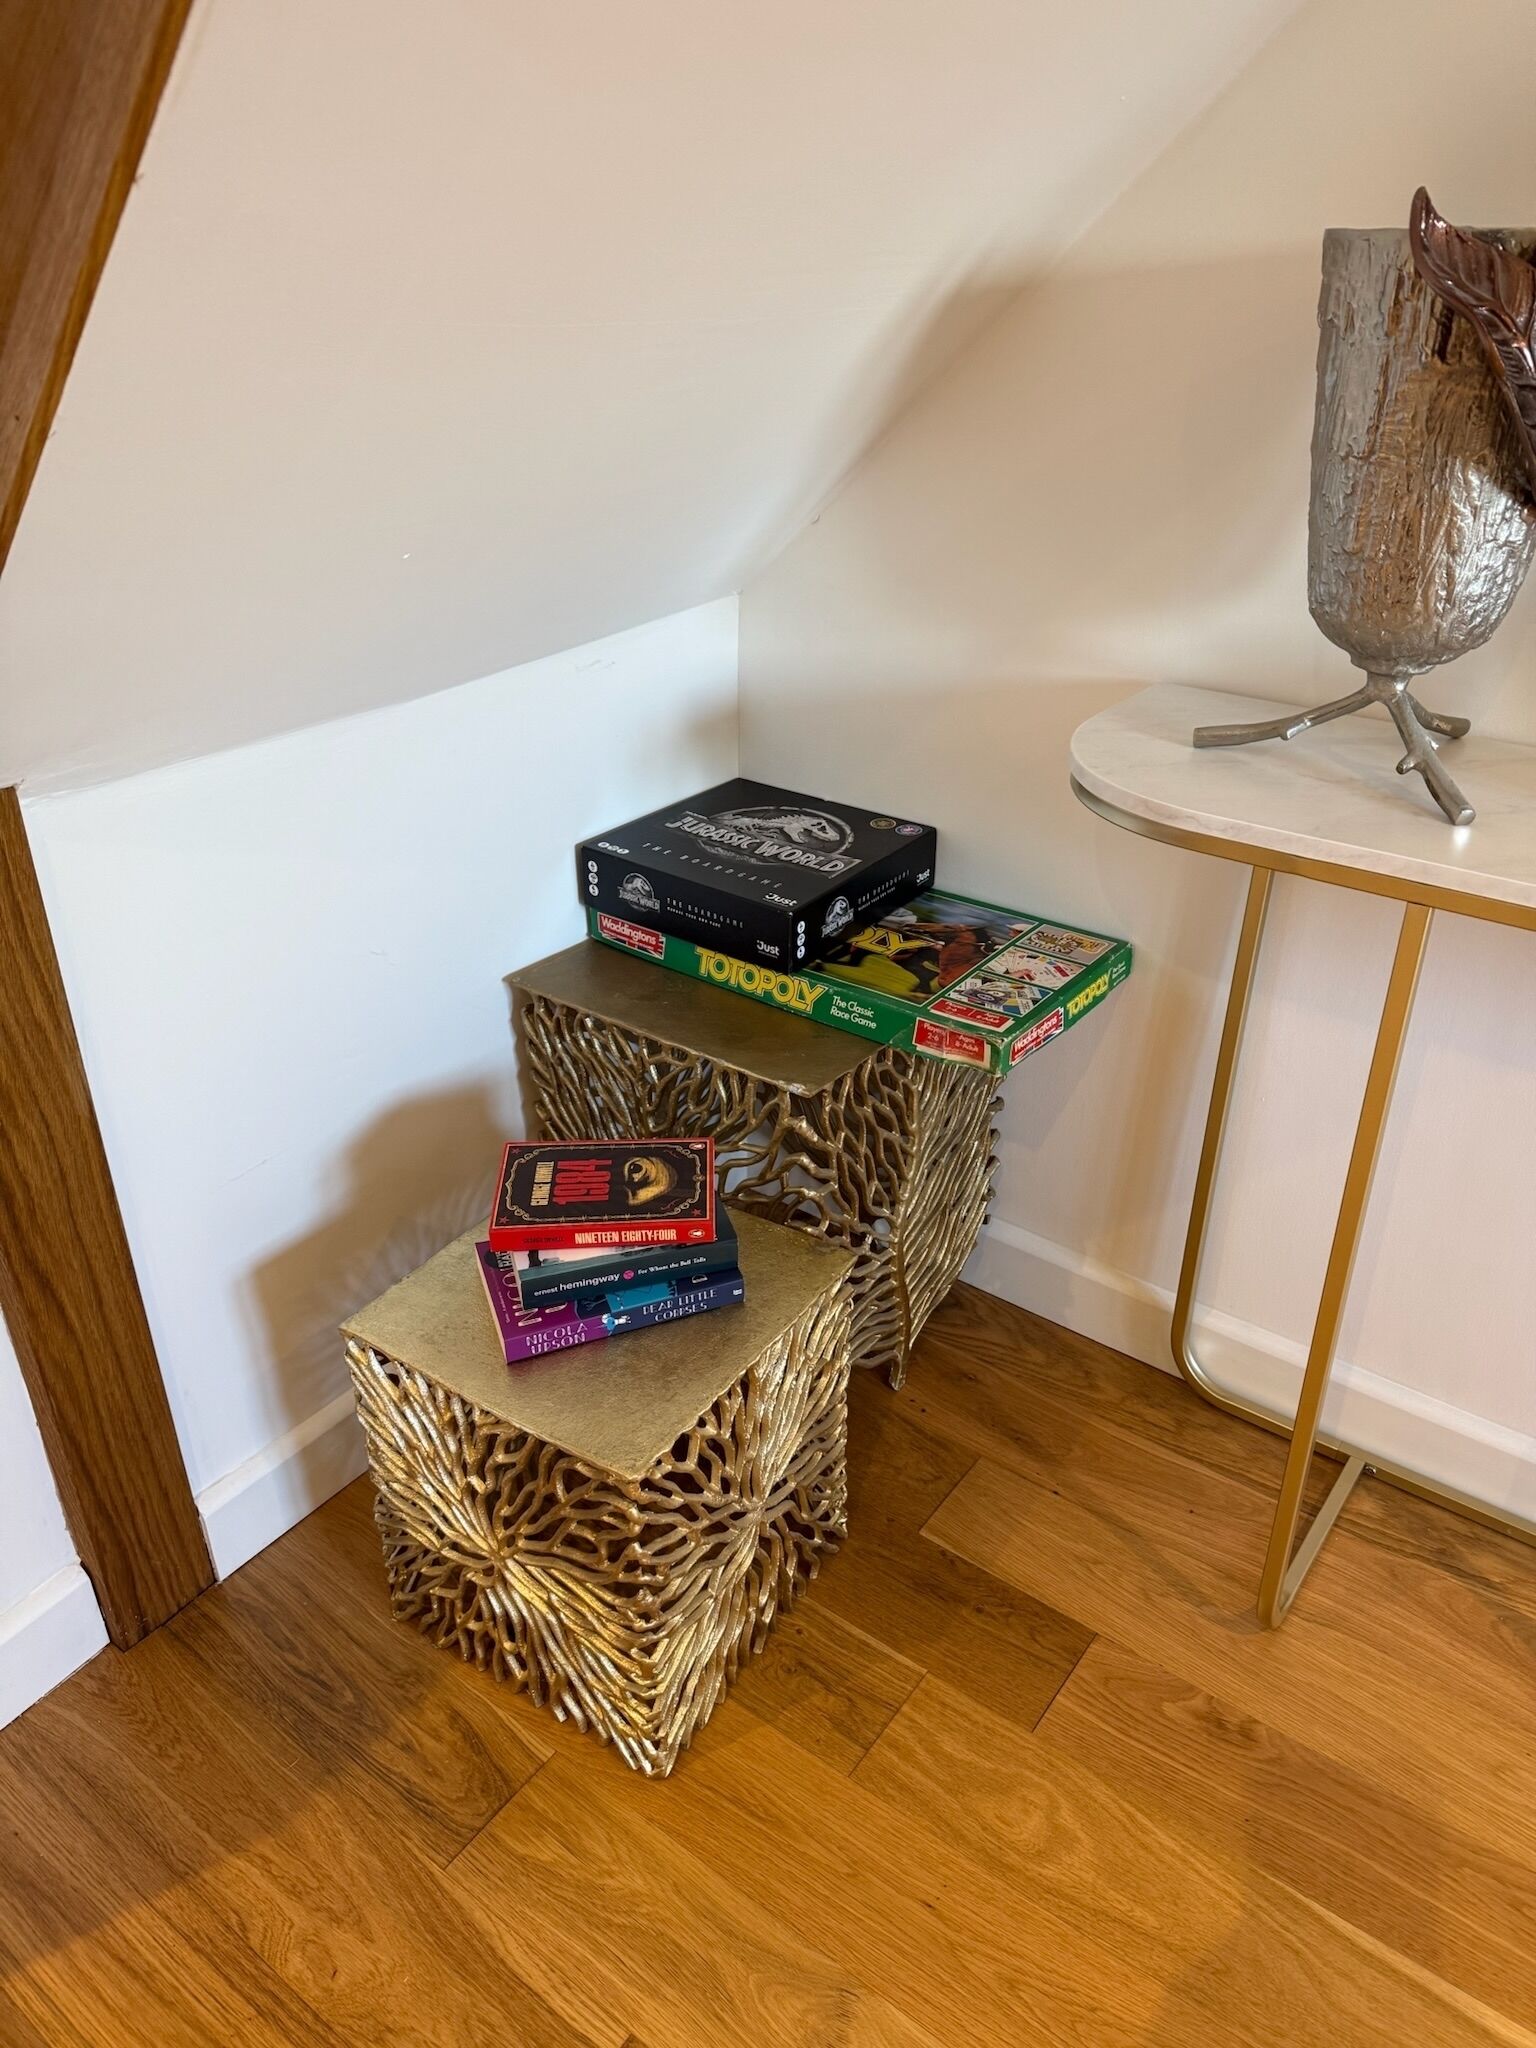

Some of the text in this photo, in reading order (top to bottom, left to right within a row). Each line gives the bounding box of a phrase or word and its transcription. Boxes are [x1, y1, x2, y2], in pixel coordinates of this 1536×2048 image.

[664, 816, 845, 873] JURASSIC WORLD
[642, 842, 782, 888] THE BOARDGAME
[764, 893, 798, 906] Just
[600, 916, 657, 945] Waddingtons
[756, 940, 780, 956] Just
[694, 944, 829, 1014] TOTOPOLY
[1066, 966, 1112, 1020] TOTOPOLY
[829, 1005, 878, 1030] Race Game
[832, 995, 875, 1018] The Classic
[1013, 1014, 1059, 1053] Waddingtons
[552, 1159, 613, 1206] 1984
[574, 1228, 678, 1244] NINETEEN EIGHTY-FOUR
[637, 1267, 648, 1275] For
[669, 1262, 679, 1270] the
[533, 1273, 621, 1297] ernest hemingway
[642, 1288, 718, 1315] DEAR LITTLE
[654, 1302, 708, 1323] CORPSES
[525, 1322, 588, 1346] NICOLA
[530, 1332, 586, 1355] UPSON
